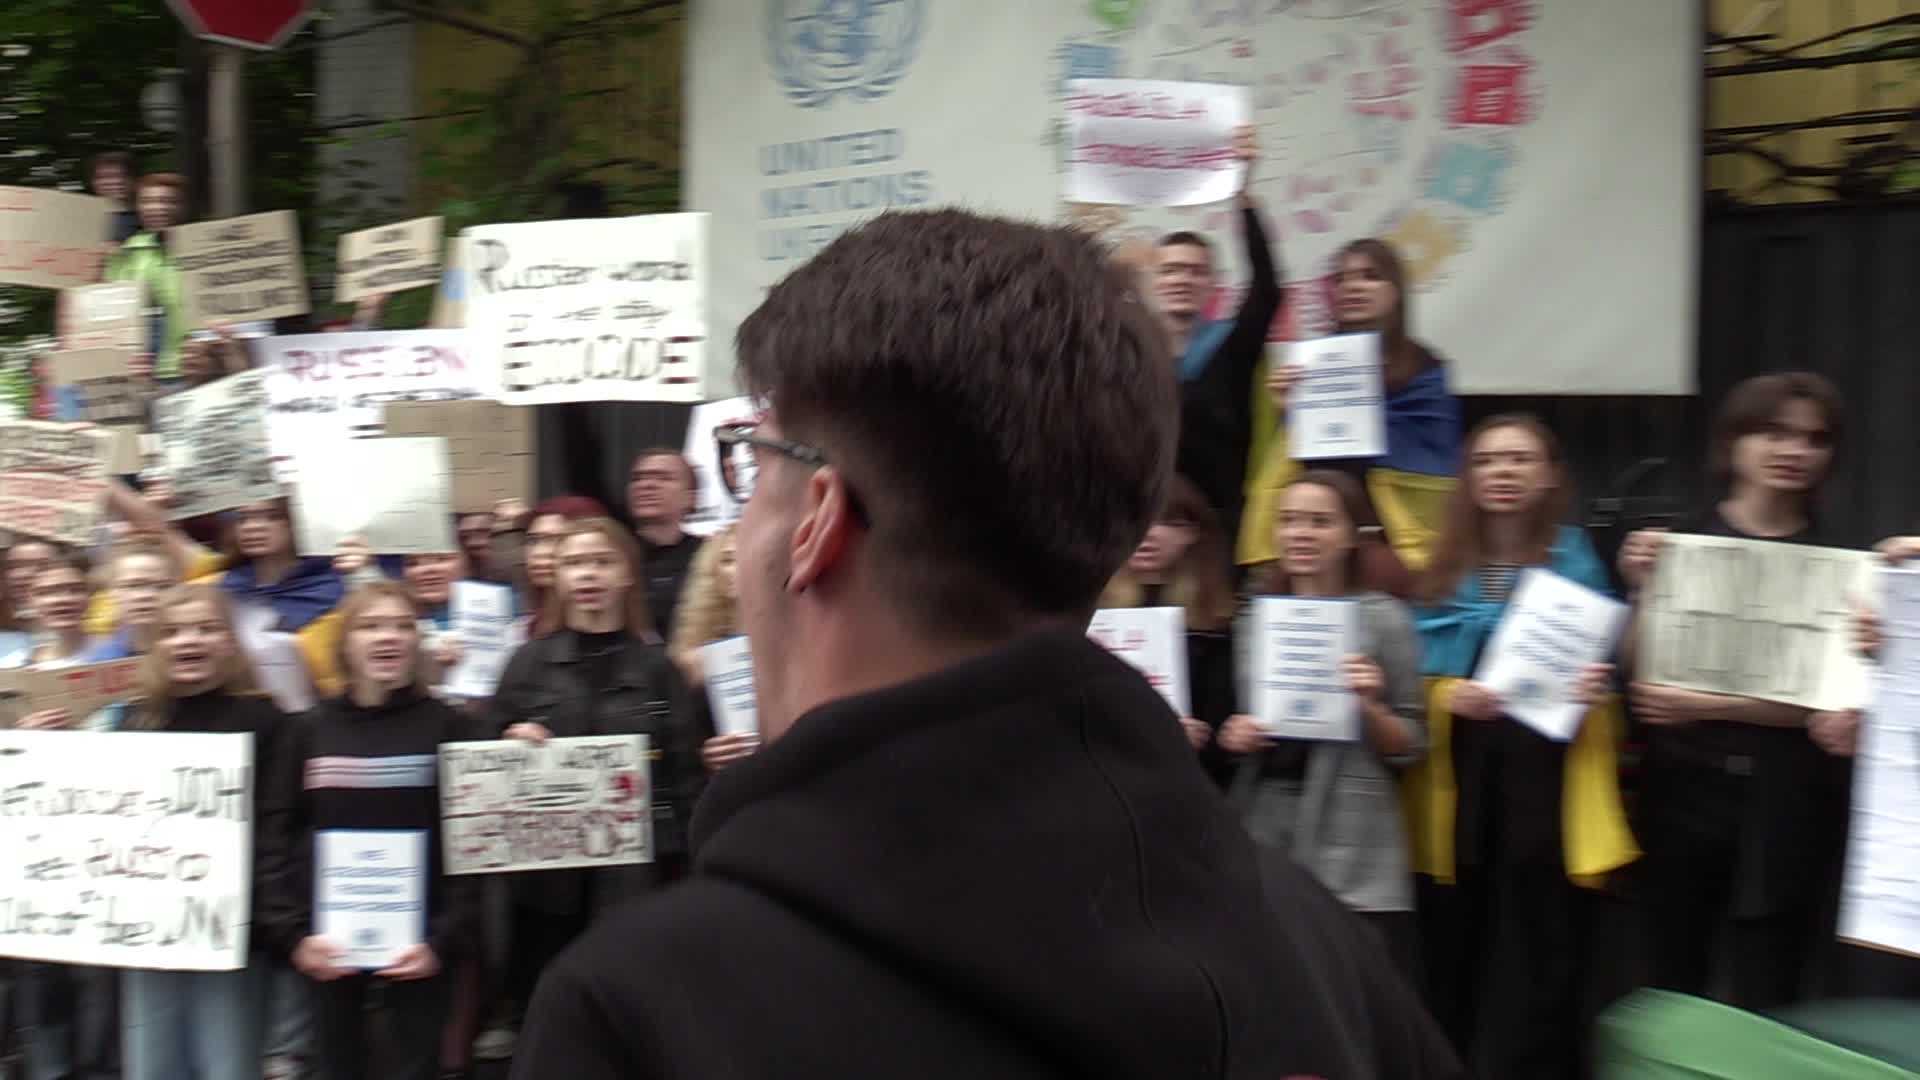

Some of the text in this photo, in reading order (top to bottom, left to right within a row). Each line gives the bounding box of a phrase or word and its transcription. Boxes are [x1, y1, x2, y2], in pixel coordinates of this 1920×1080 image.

[760, 128, 904, 176] UNITED
[760, 170, 932, 219] NATIONS
[503, 333, 706, 394] ECOCIDE
